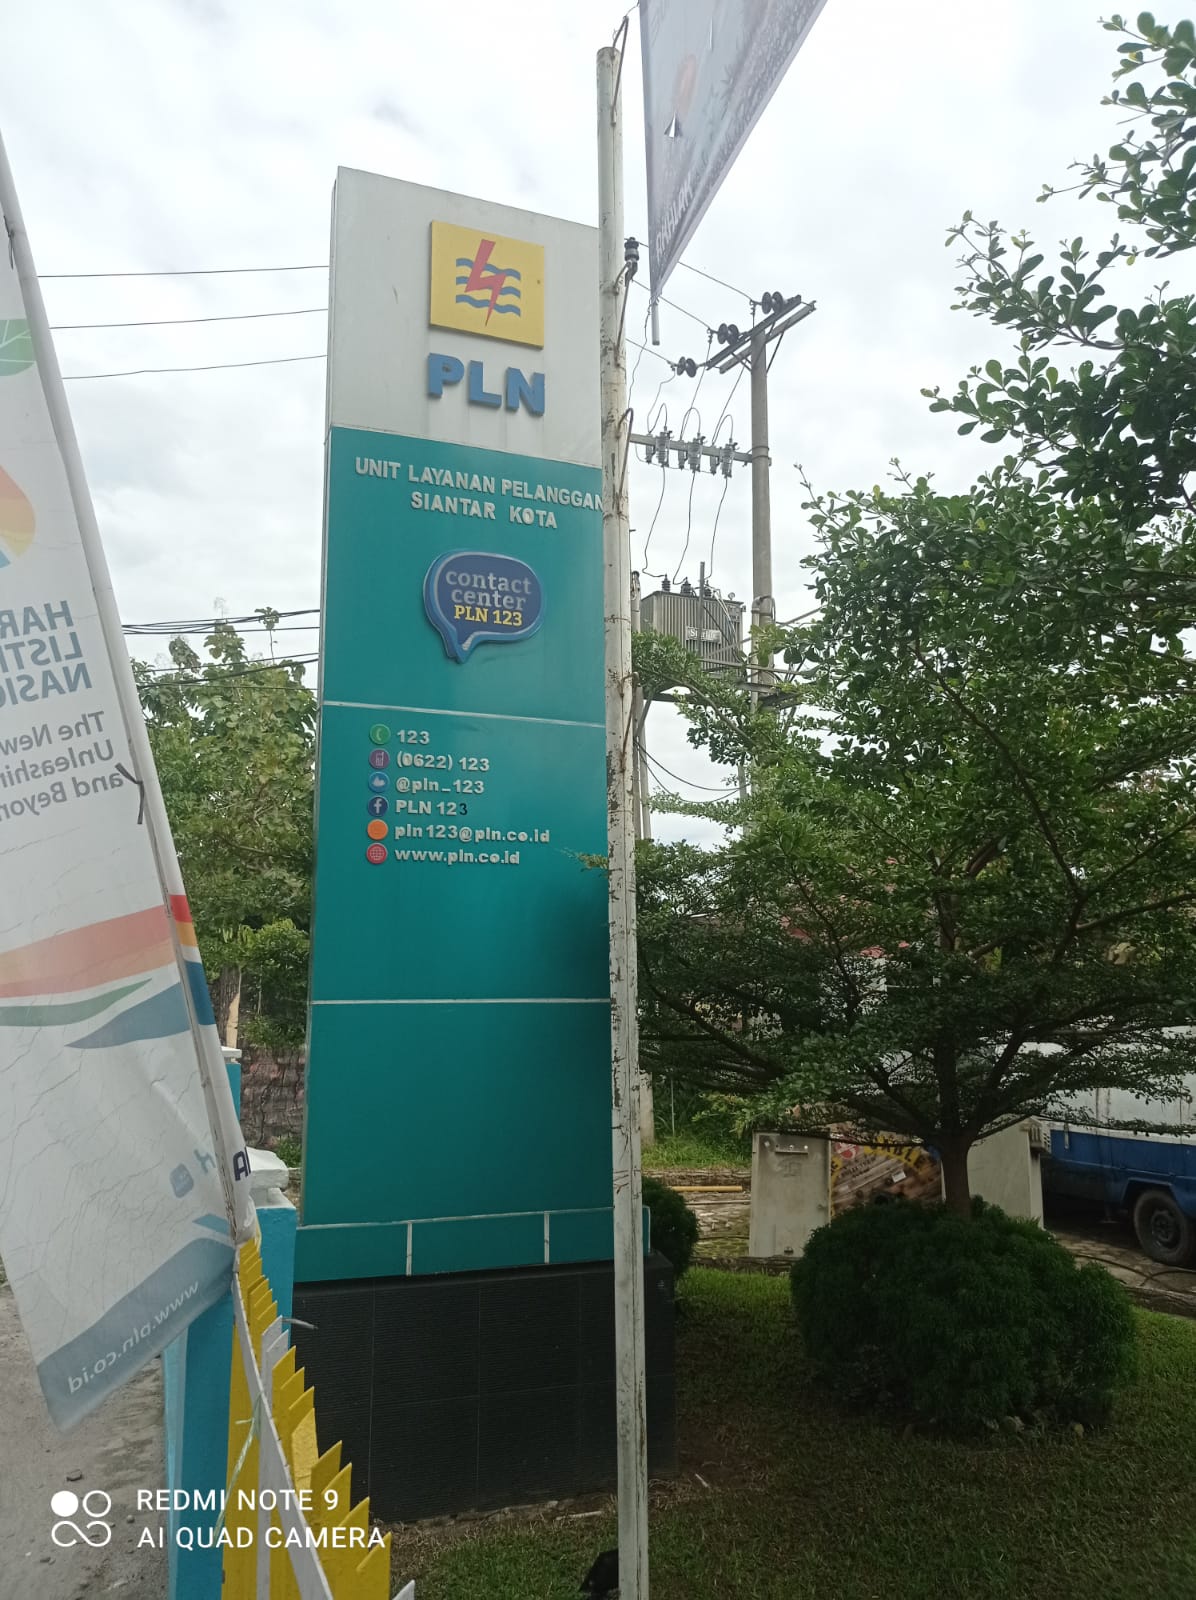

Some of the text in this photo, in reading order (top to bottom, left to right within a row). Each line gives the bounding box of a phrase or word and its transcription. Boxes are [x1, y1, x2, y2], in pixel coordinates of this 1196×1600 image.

[427, 352, 546, 417] PLN
[355, 457, 603, 512] UNIT LAYANAN PELANGGAN
[411, 492, 558, 529] SIANTAR KOTA
[445, 571, 532, 594] contact
[451, 588, 526, 611] center
[453, 604, 523, 627] PLN 123
[396, 729, 430, 745] 123
[396, 751, 490, 771] (0622) 123
[395, 799, 468, 816] PLN 123
[394, 848, 520, 865] www.pln.co.id
